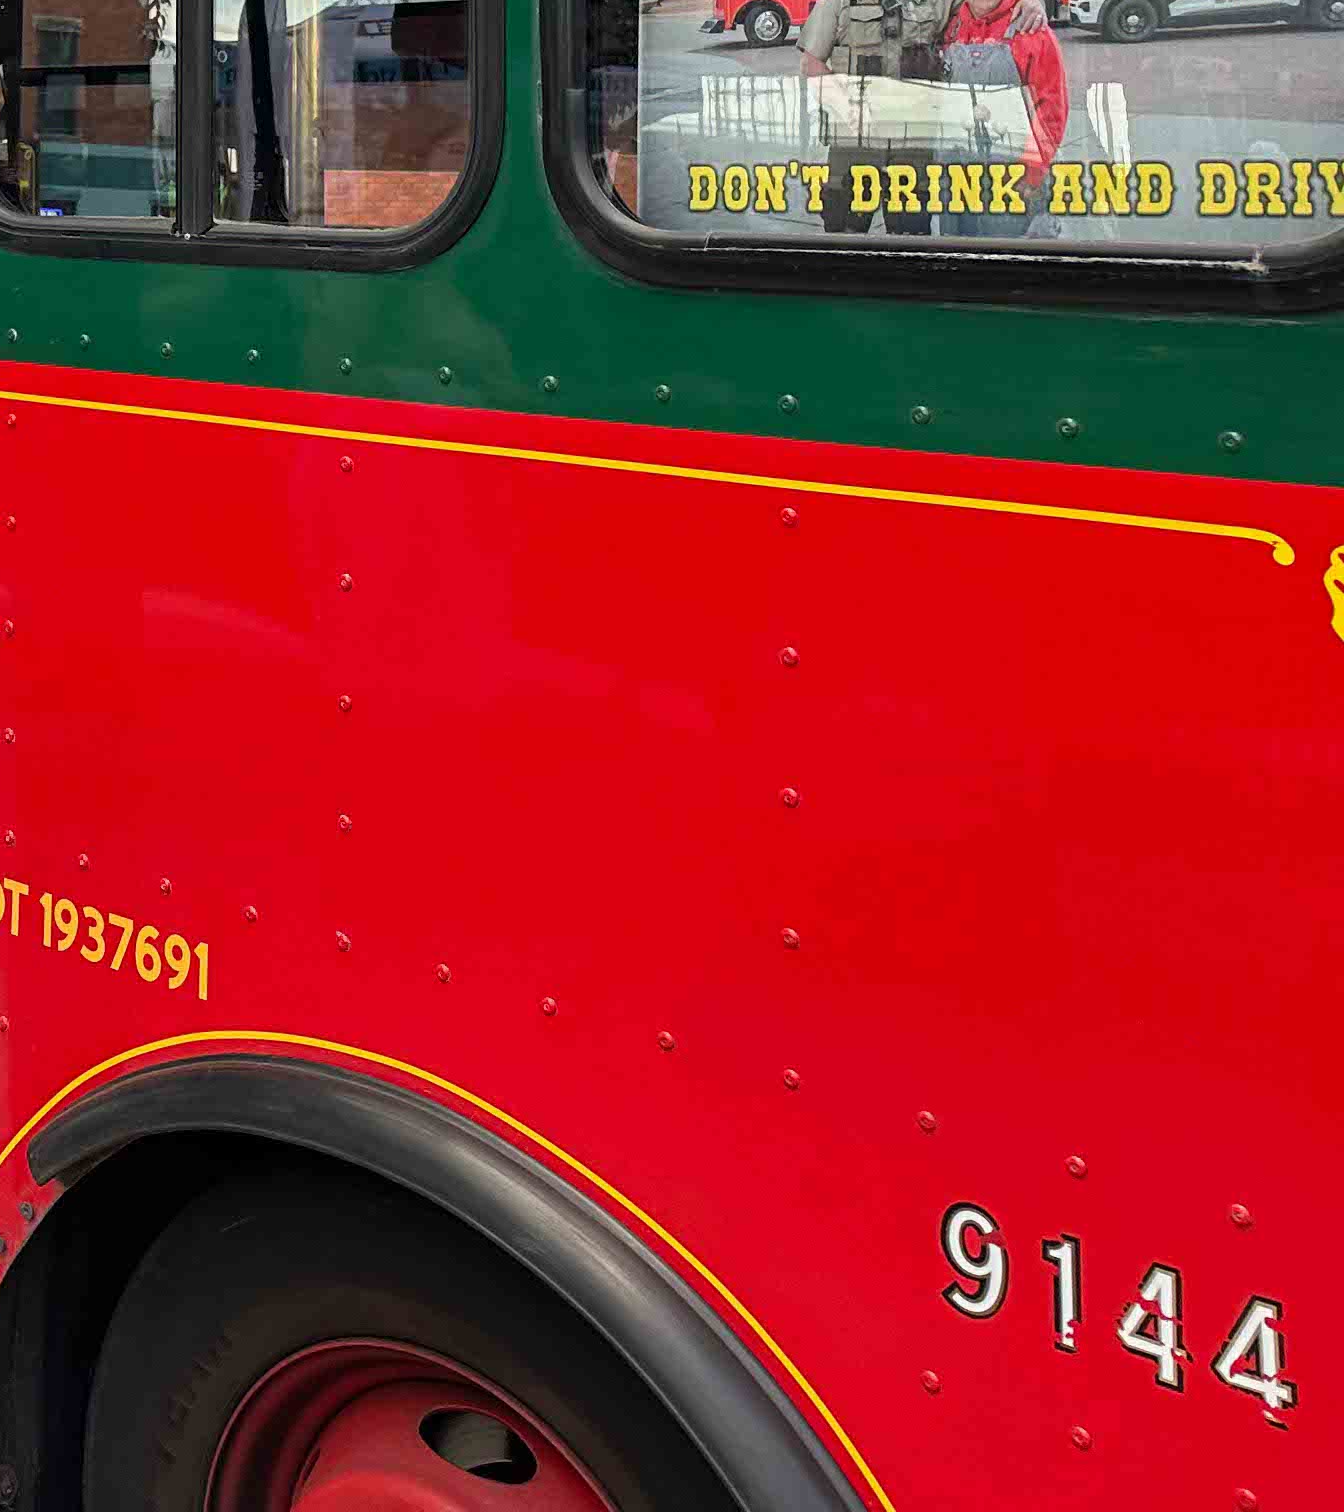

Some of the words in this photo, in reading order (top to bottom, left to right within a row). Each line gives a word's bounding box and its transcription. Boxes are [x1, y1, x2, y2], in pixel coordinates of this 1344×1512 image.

[686, 163, 831, 214] DON'T
[849, 162, 1026, 215] DRINK
[1048, 161, 1174, 216] AND
[1196, 160, 1344, 216] DRIV
[39, 892, 209, 1001] 1937691
[939, 1200, 1299, 1431] 9144
